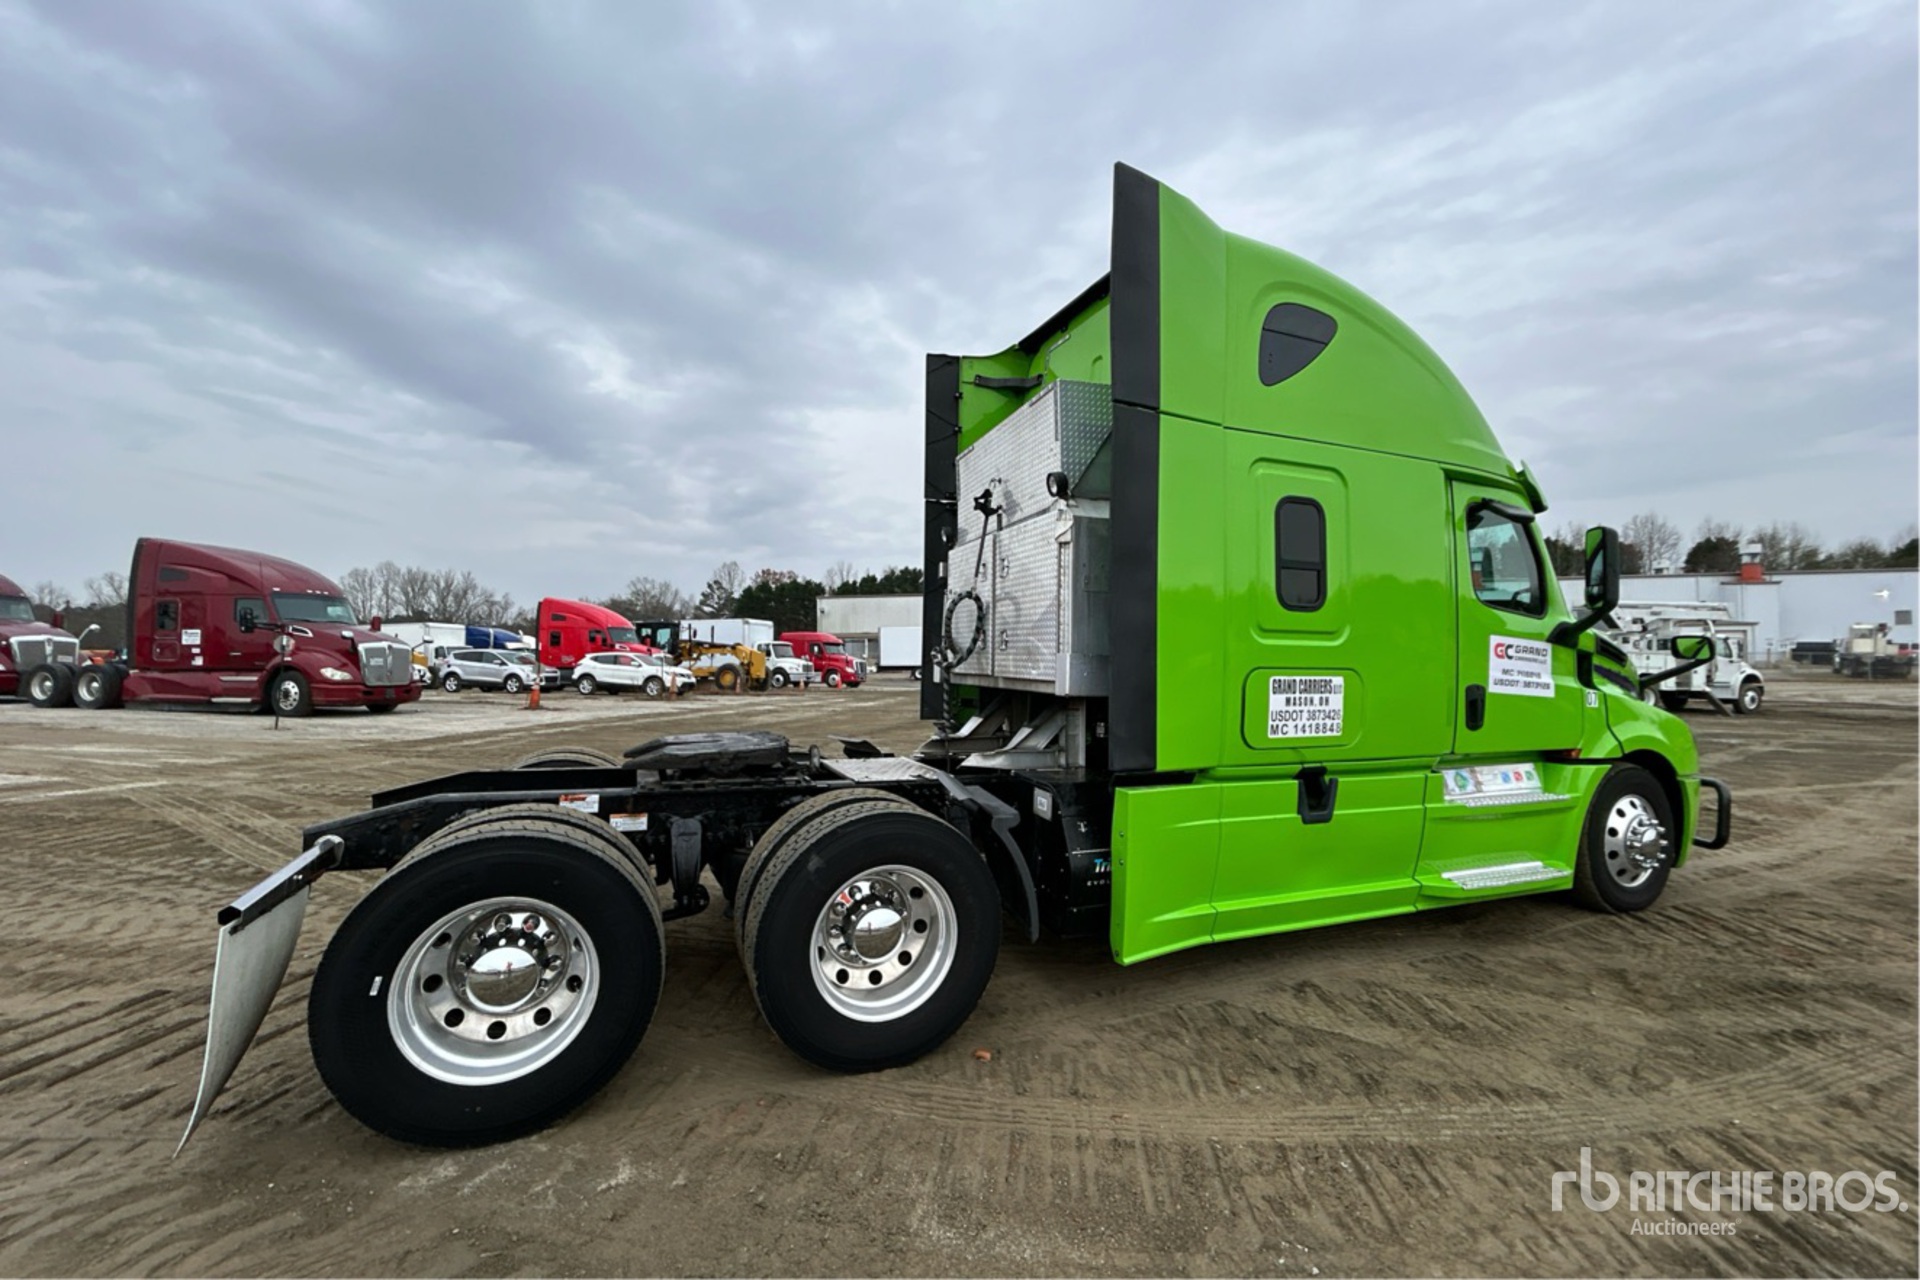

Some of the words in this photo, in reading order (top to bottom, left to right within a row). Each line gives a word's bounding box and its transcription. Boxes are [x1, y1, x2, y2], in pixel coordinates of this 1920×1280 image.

[1514, 644, 1548, 657] GRAND
[1501, 668, 1515, 676] MC
[1272, 678, 1297, 695] GRAND
[1298, 678, 1333, 695] CARRIERS
[1493, 678, 1520, 687] USDOT
[1271, 709, 1304, 722] USDOT
[1270, 723, 1289, 736] MC
